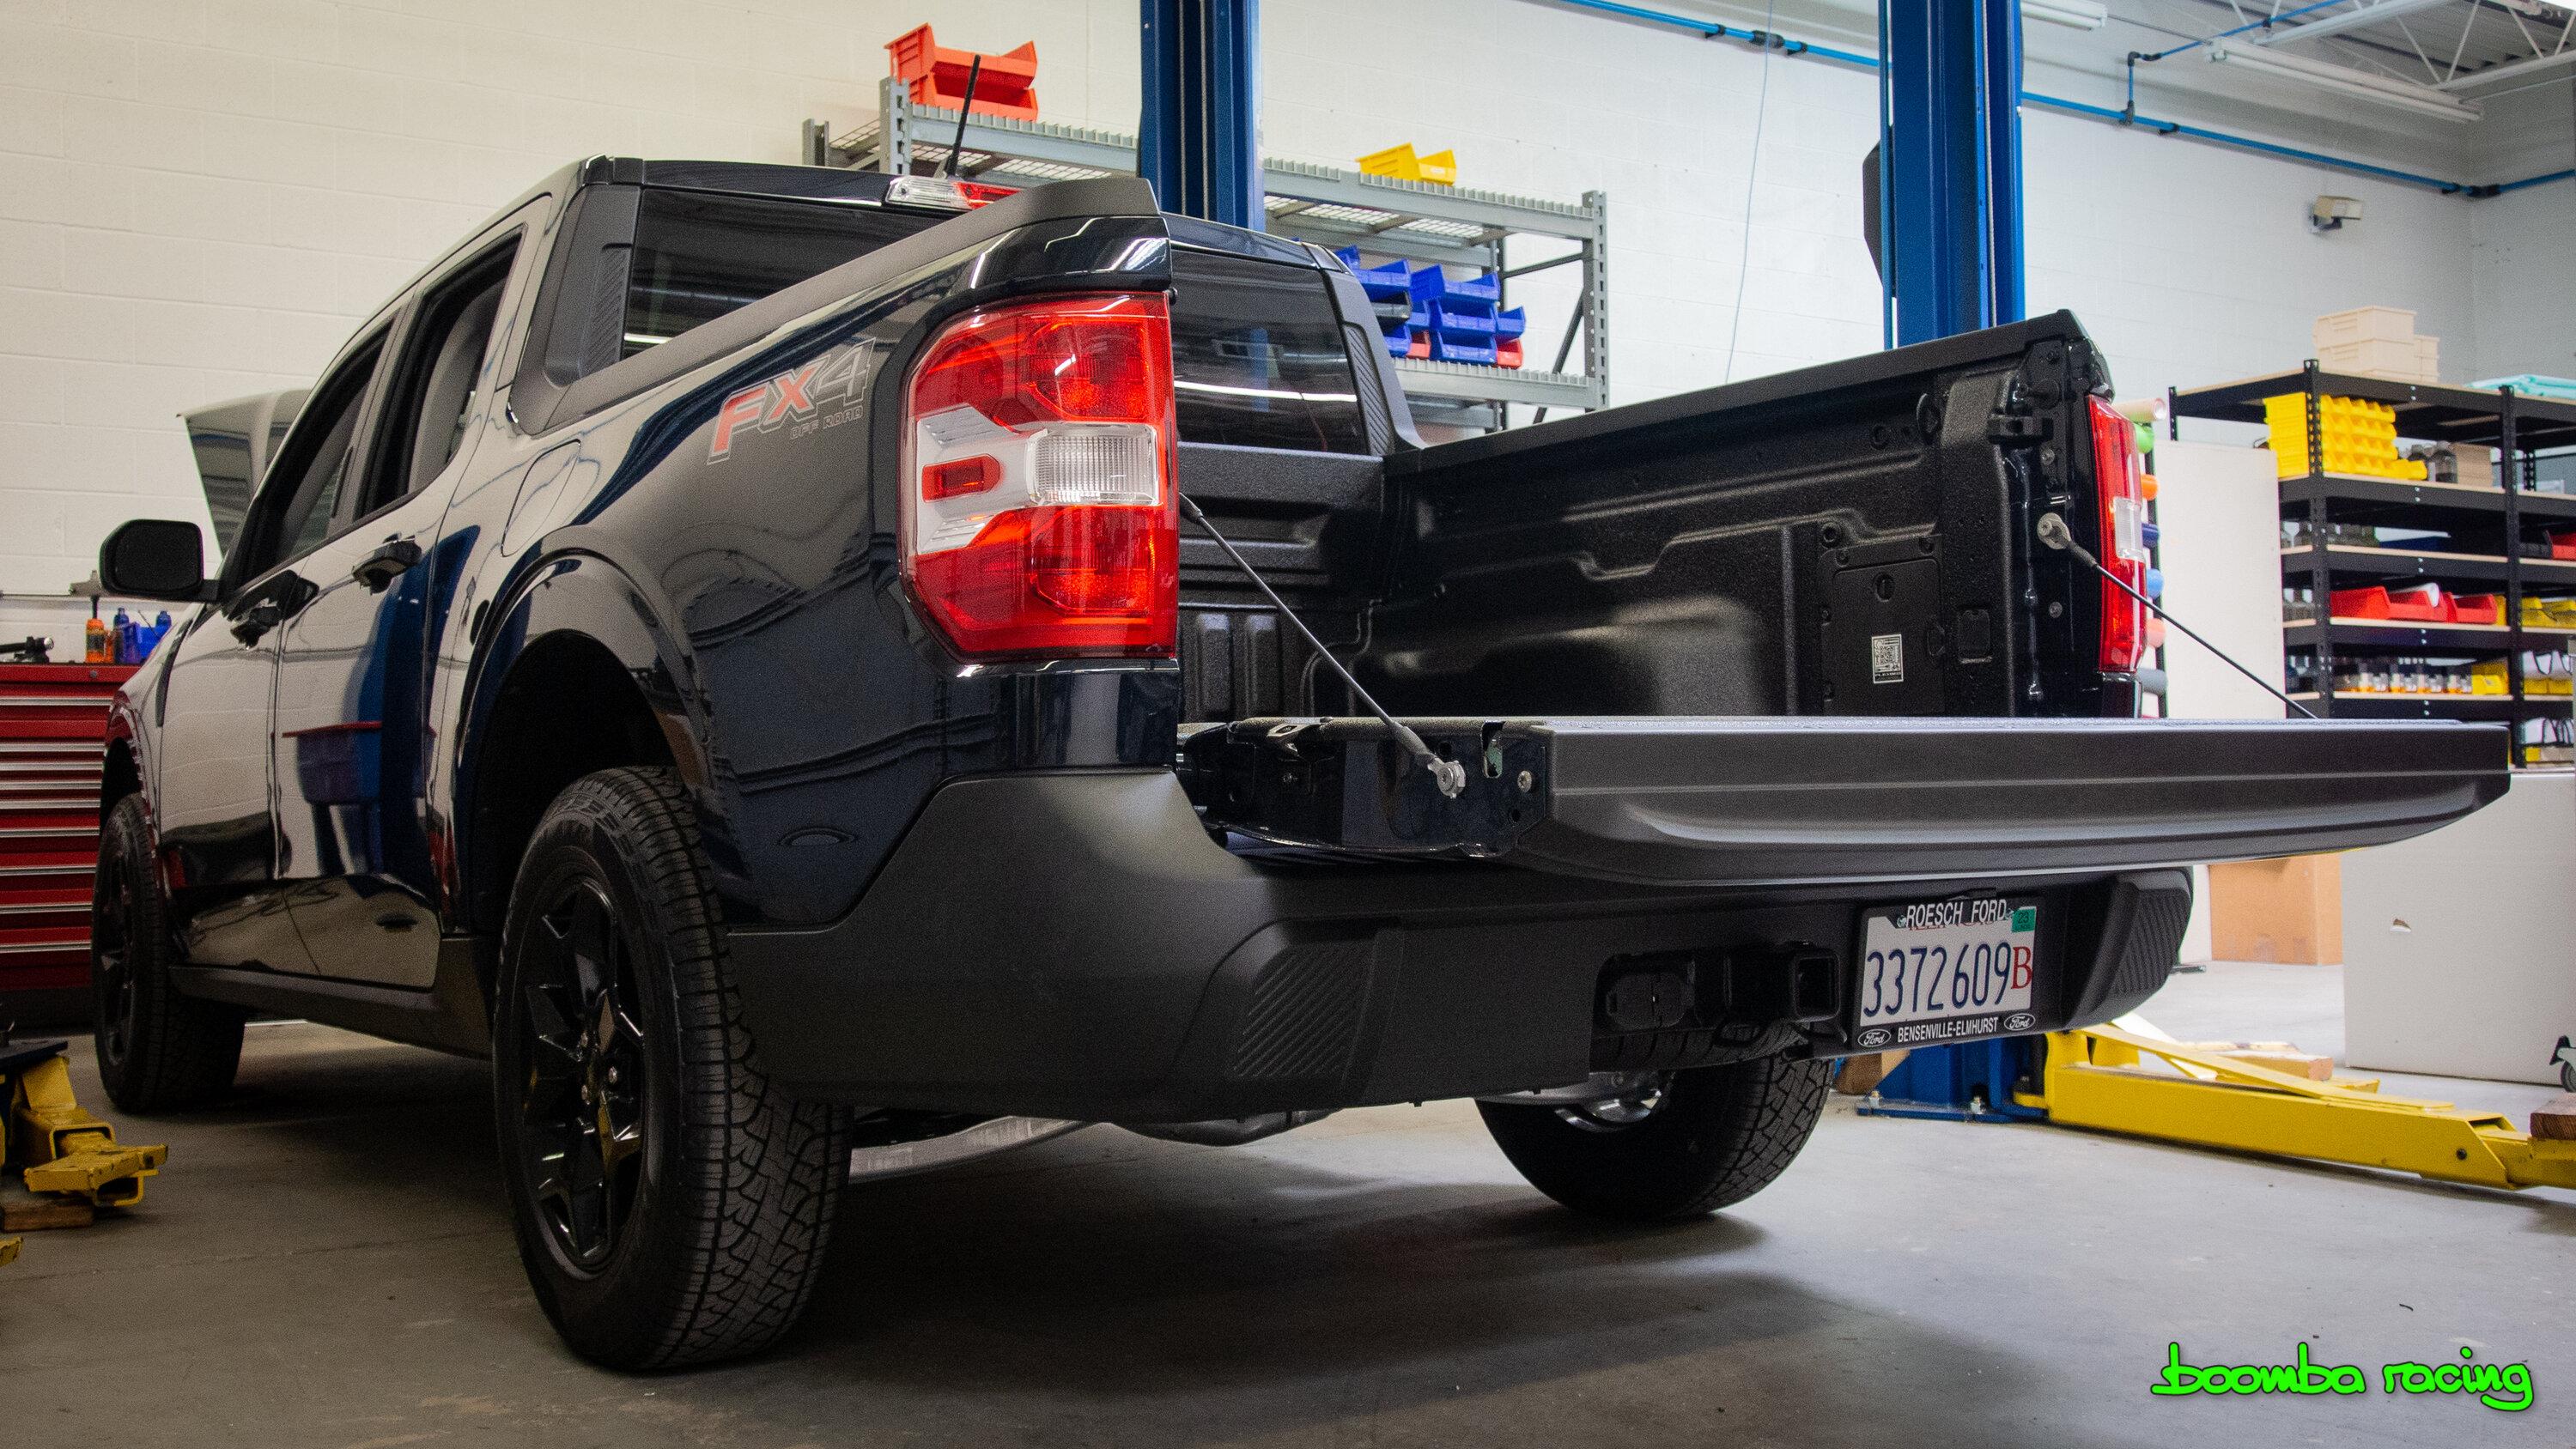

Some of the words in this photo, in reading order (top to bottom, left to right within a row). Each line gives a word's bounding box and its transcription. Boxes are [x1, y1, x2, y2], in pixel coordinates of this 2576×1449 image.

[707, 336, 876, 465] FX4
[792, 420, 819, 440] OFF
[823, 406, 863, 429] ROAD
[1905, 901, 1964, 927] ROESCH
[1971, 899, 2007, 923] FORD
[1898, 1017, 1999, 1043] BENSENVILLE-ELMHURST
[2009, 1016, 2030, 1029] Ford
[1864, 1031, 1886, 1046] Ford
